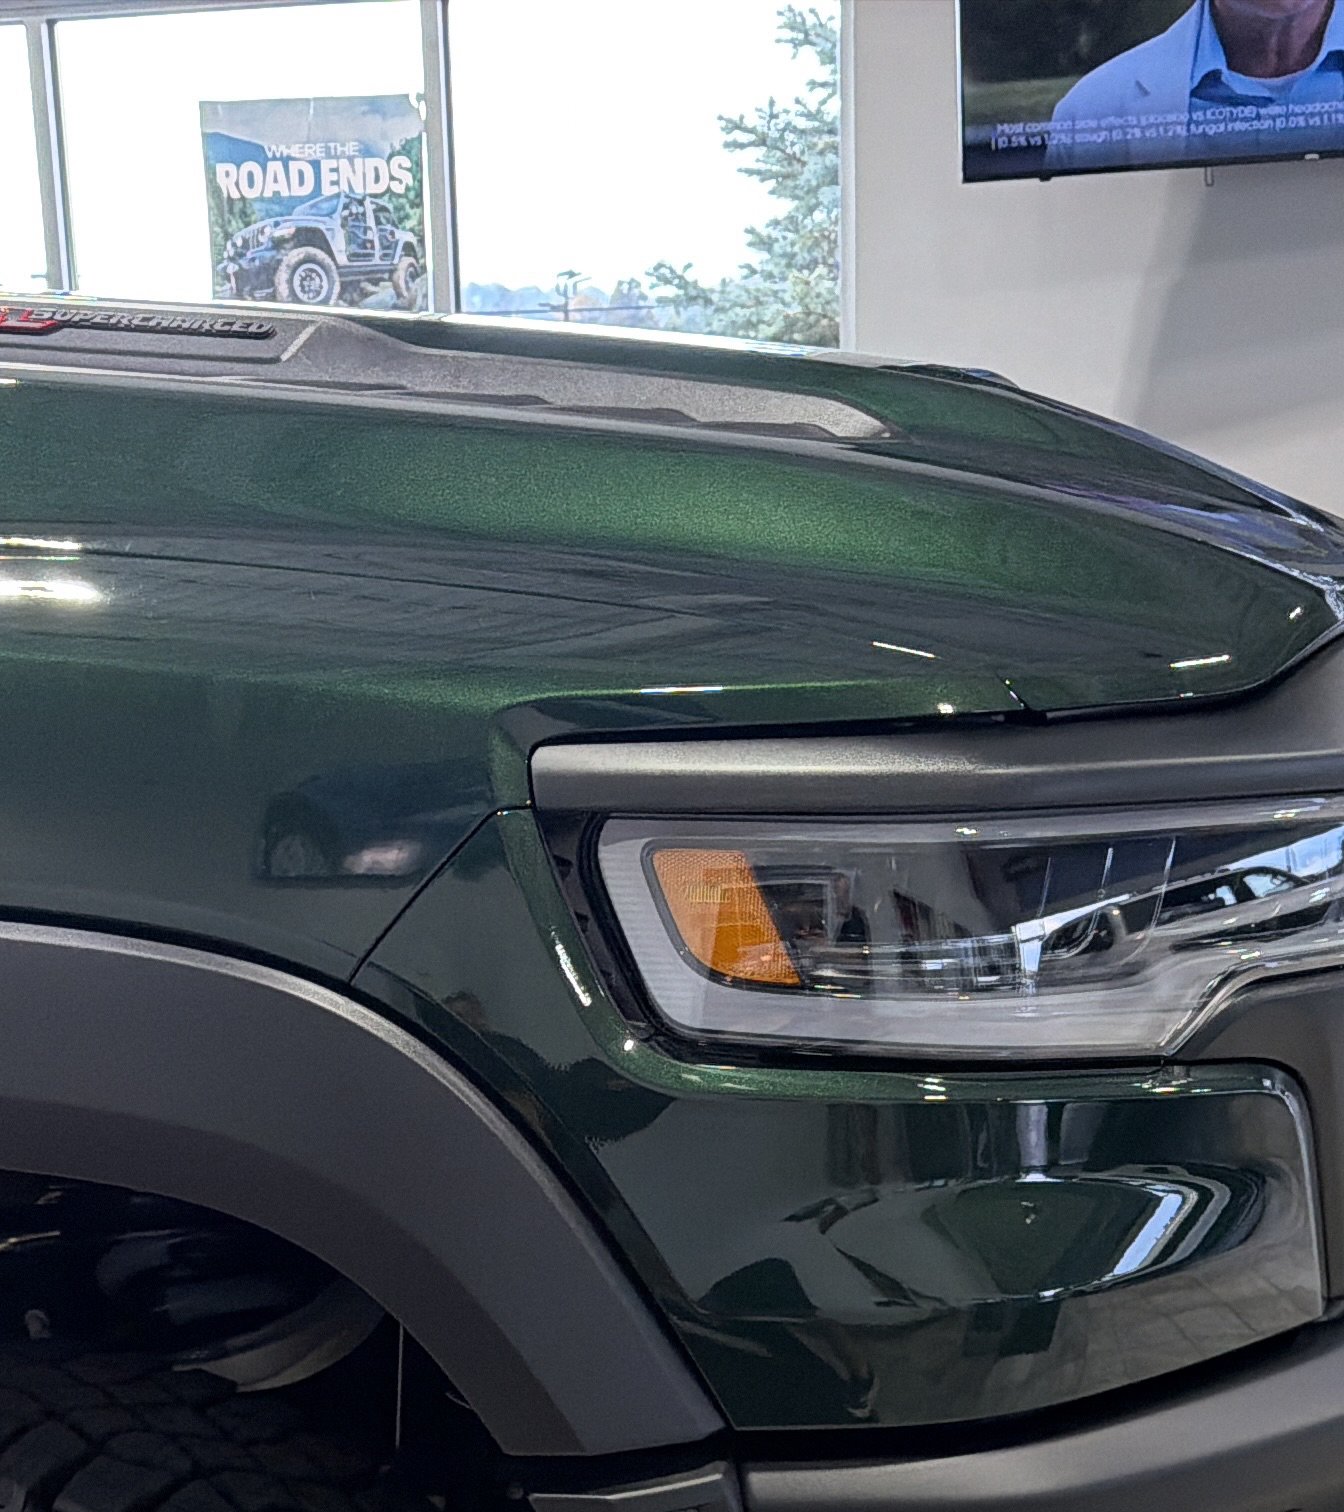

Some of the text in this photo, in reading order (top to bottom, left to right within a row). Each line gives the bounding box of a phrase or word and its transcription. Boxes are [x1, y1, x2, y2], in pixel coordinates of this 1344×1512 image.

[263, 141, 360, 159] WHERE THE
[216, 155, 414, 199] ROAD ENDS
